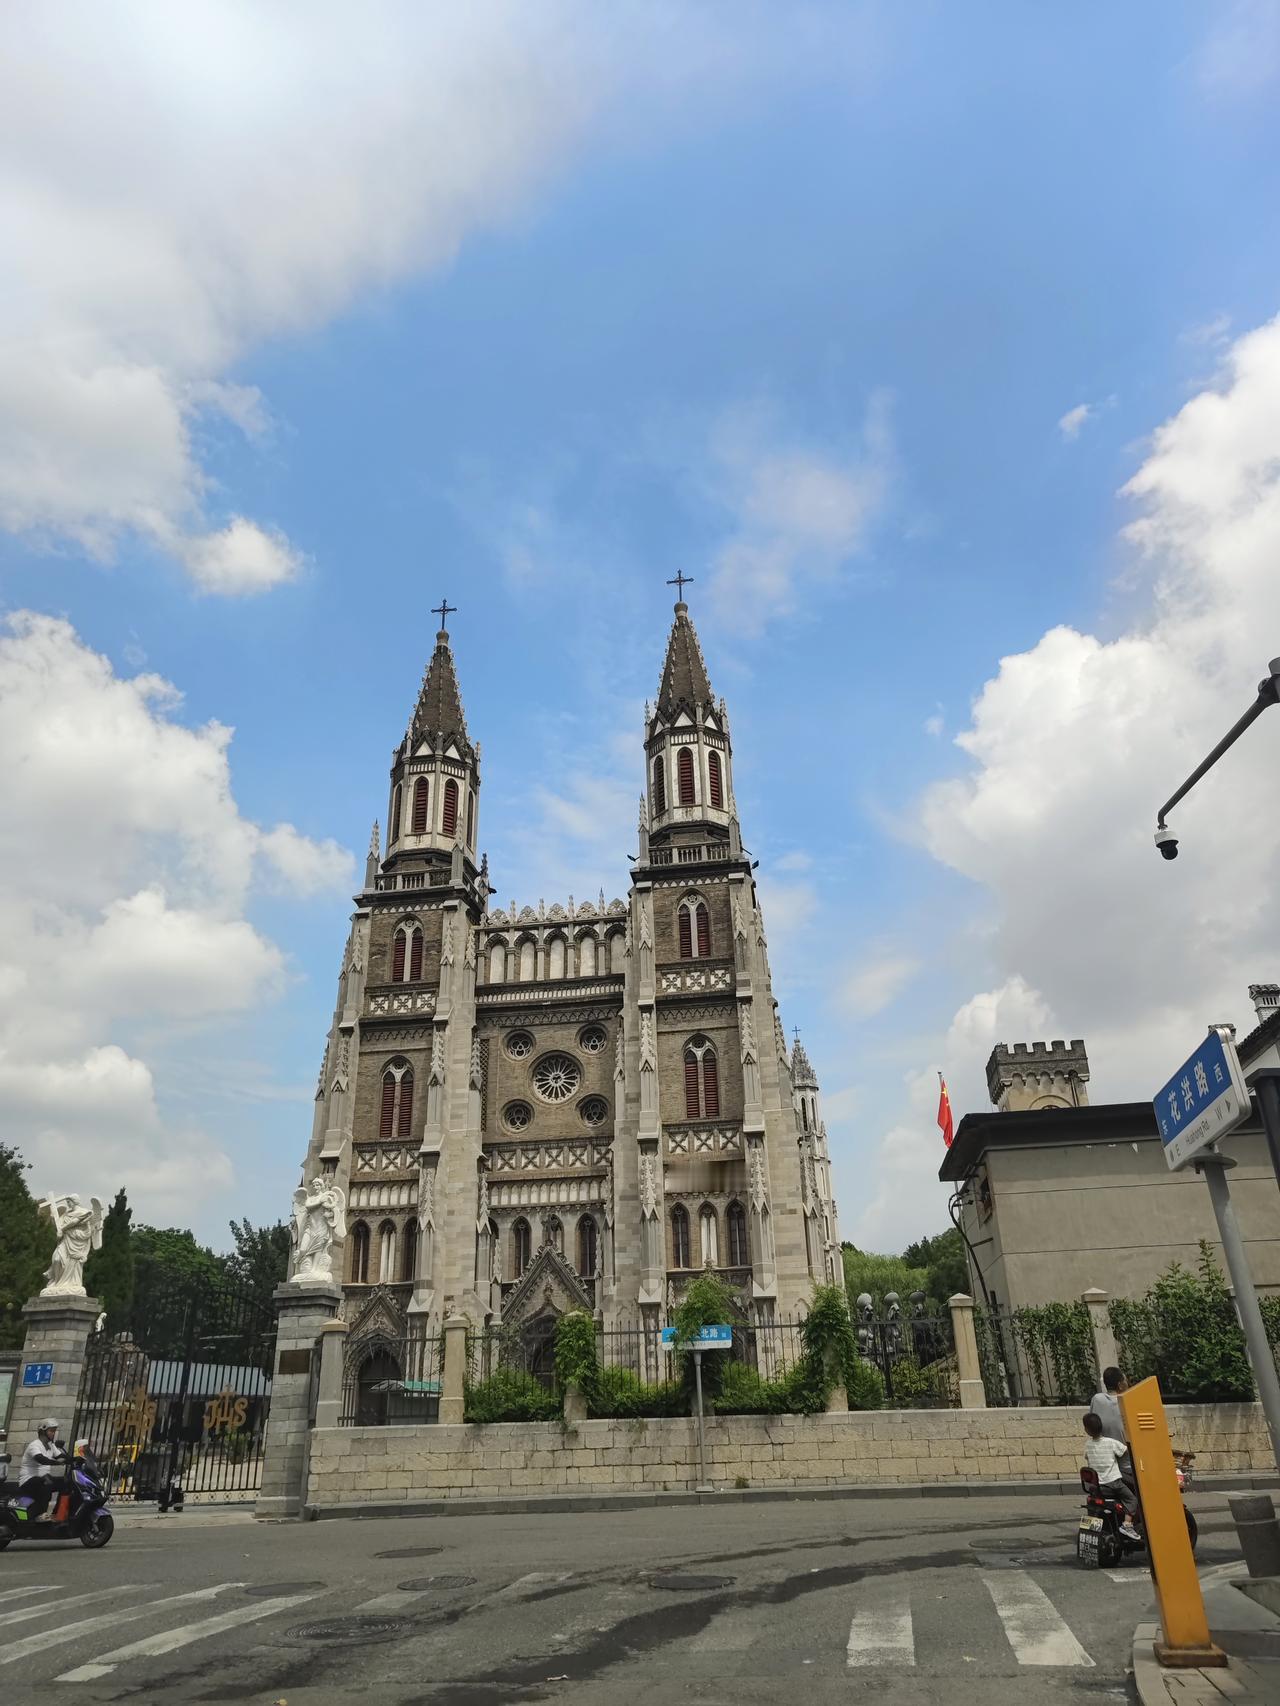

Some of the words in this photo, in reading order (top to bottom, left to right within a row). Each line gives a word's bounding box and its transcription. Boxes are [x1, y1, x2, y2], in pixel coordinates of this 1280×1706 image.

[1168, 1060, 1209, 1125] 花洪路
[1214, 1107, 1223, 1120] W
[35, 1371, 41, 1382] 1
